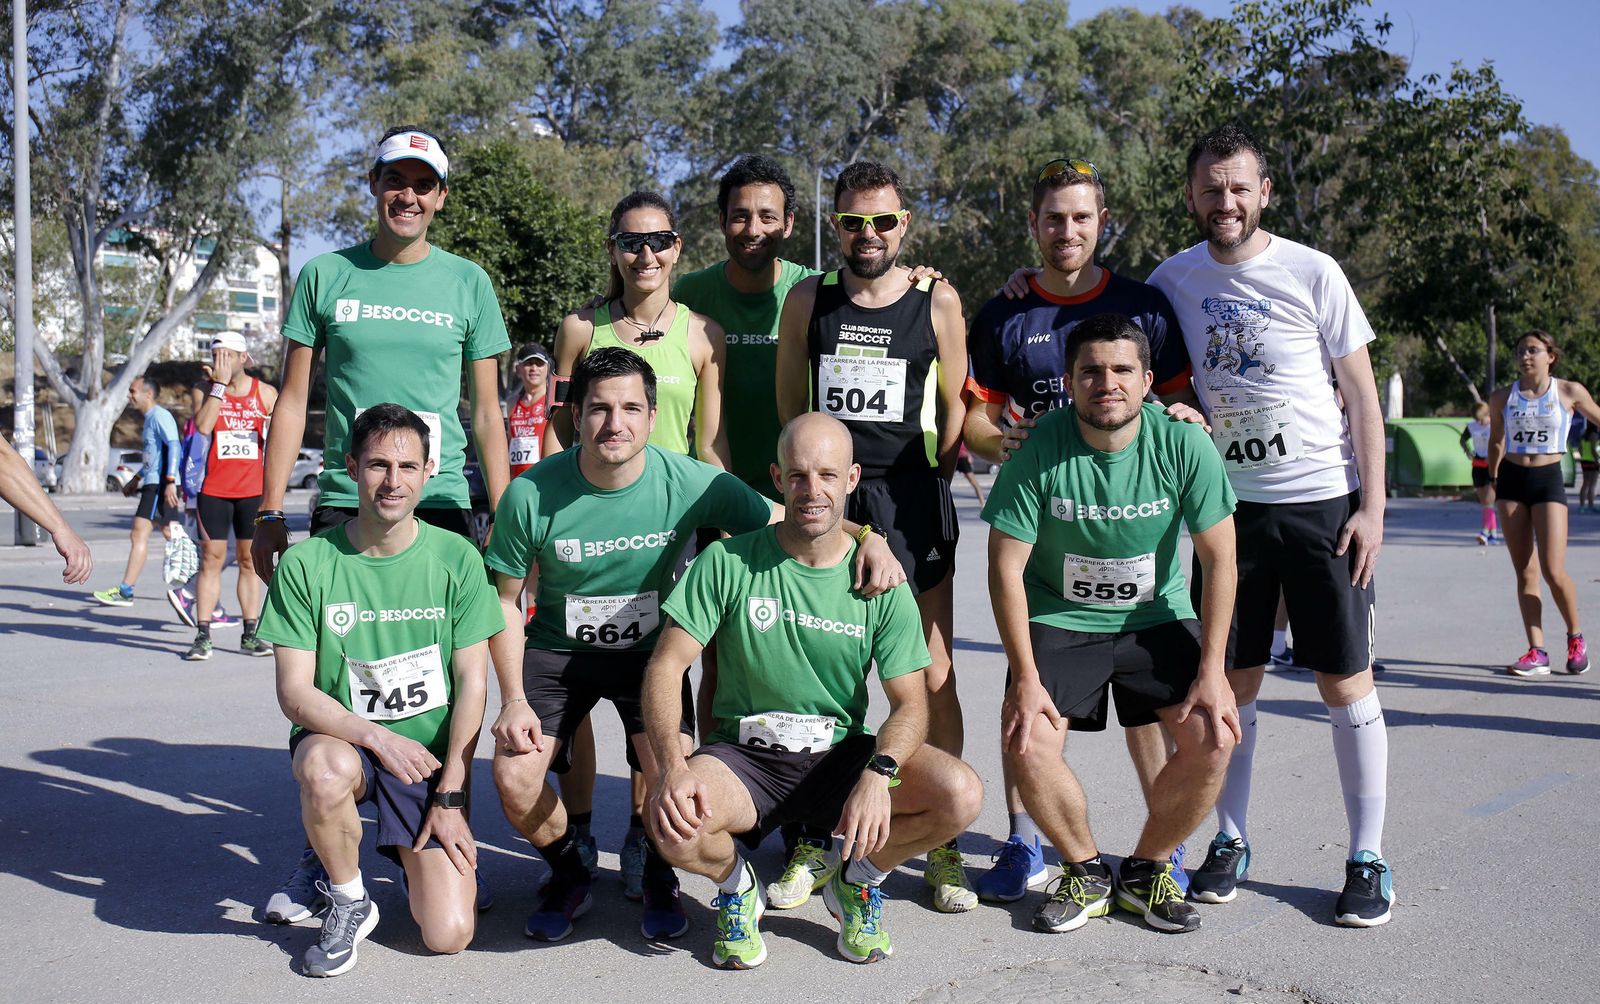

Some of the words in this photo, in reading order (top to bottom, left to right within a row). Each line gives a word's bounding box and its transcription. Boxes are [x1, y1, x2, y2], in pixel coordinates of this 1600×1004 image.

[361, 304, 454, 329] BESOCCER
[840, 323, 857, 331] CLUB
[857, 325, 893, 335] DEPORTIVO
[725, 334, 739, 345] CD
[838, 331, 892, 345] BESOCCER
[829, 357, 857, 365] CARRERA
[825, 387, 888, 414] 504
[1219, 411, 1244, 419] CARRERA
[1262, 402, 1286, 412] PRENSA
[1513, 430, 1549, 443] 475
[222, 444, 250, 456] 236
[1224, 432, 1287, 464] 401
[511, 450, 531, 462] 207
[1077, 497, 1170, 520] BESOCCER
[584, 529, 677, 557] BESOCCER
[1075, 558, 1105, 566] CARRERA
[1072, 580, 1138, 600] 559
[627, 594, 652, 603] PRENSA
[360, 610, 376, 622] CD
[576, 621, 642, 644] 664
[408, 649, 433, 660] PRENSA
[359, 681, 428, 713] 745
